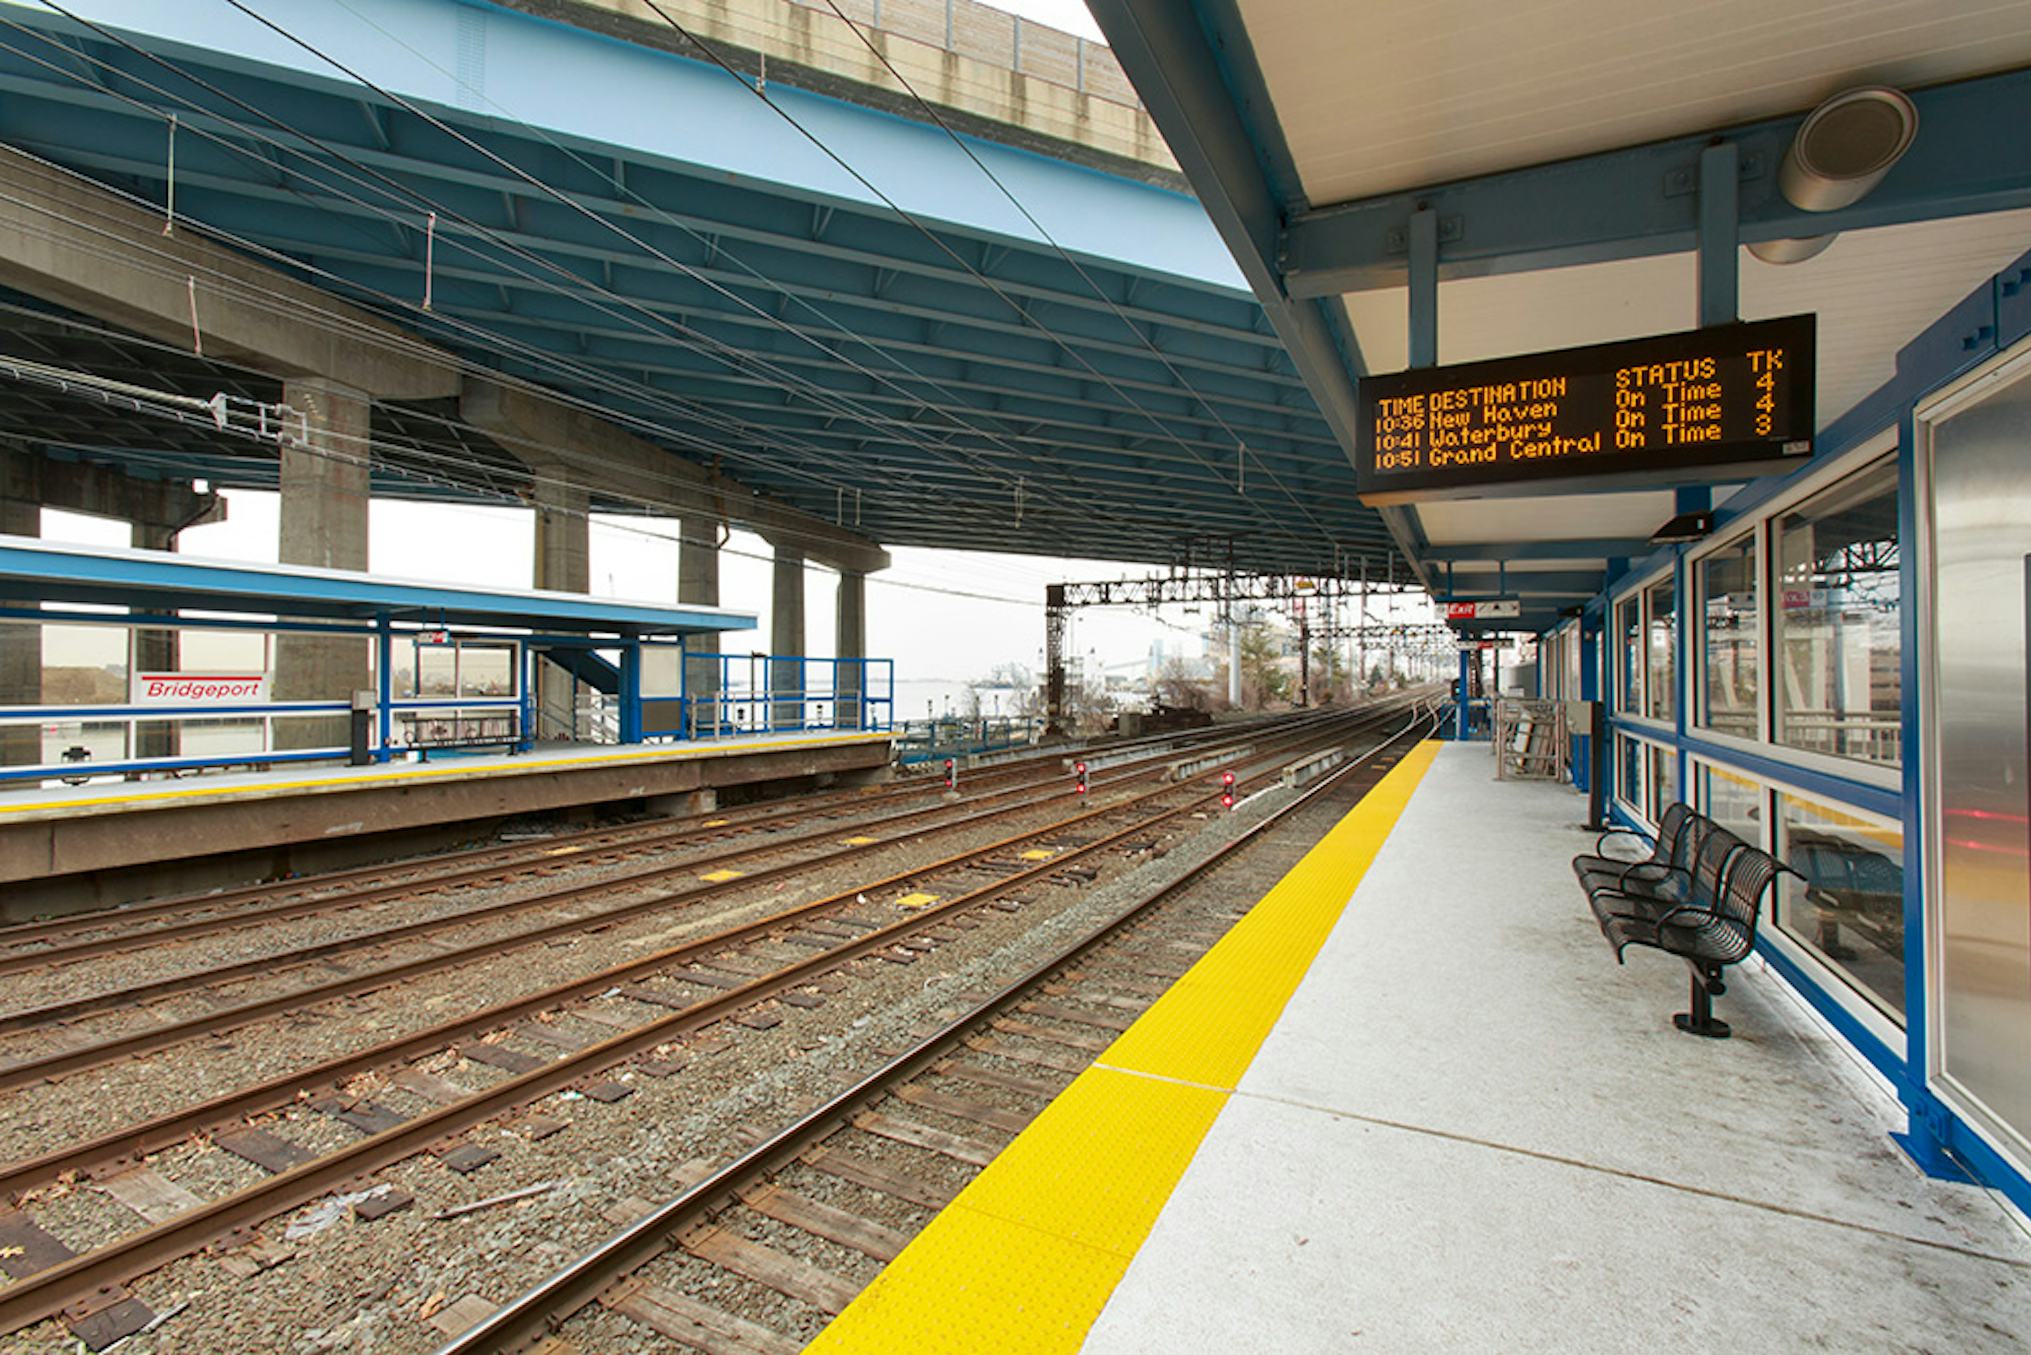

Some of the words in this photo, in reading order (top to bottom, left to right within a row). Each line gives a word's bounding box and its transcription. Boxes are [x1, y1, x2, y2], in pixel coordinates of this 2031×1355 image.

[1375, 415, 1425, 433] 10:36
[1429, 411, 1470, 430] New
[1483, 402, 1558, 424] Haven
[1616, 390, 1646, 408] On
[1661, 382, 1722, 403] Time
[1756, 371, 1775, 392] 4
[1379, 395, 1425, 417] TIME
[1429, 376, 1566, 412] DESTINATION
[1616, 356, 1716, 388] STATUS
[1746, 349, 1783, 372] TK
[1375, 432, 1420, 452] 10:41
[1429, 421, 1552, 448] Waterbury
[1616, 409, 1645, 428] On
[1661, 403, 1722, 423] Time
[1756, 392, 1775, 413] 4
[1375, 450, 1420, 470] 10:51
[1429, 442, 1497, 467] Grand
[1510, 432, 1601, 459] Central
[1616, 429, 1645, 448] On
[1661, 423, 1722, 444] Time
[1755, 413, 1772, 436] 3
[1449, 603, 1474, 614] Exit
[148, 682, 258, 698] Bridgeport
